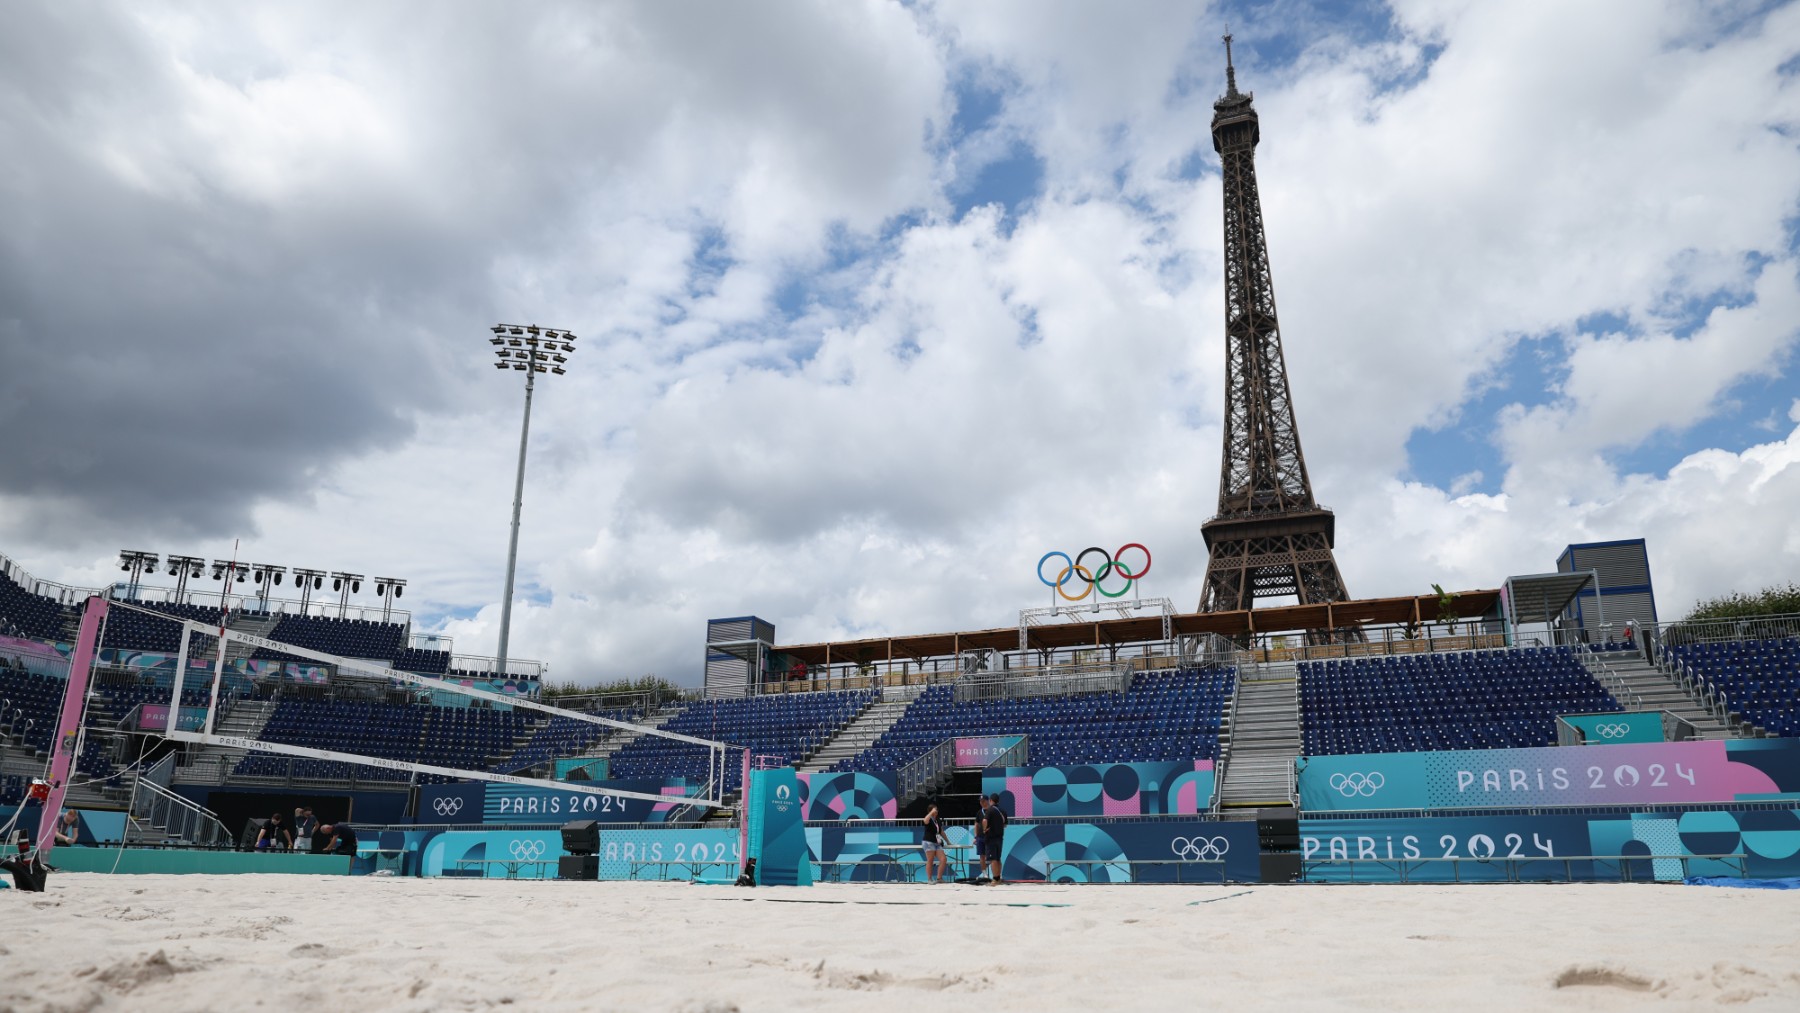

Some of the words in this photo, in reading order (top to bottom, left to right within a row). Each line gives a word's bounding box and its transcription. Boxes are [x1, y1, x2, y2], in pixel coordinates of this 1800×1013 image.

[266, 640, 288, 651] 2024
[250, 742, 272, 750] 2024
[1586, 763, 1696, 788] 2024
[569, 796, 626, 813] 2024
[1439, 832, 1554, 859] 2024
